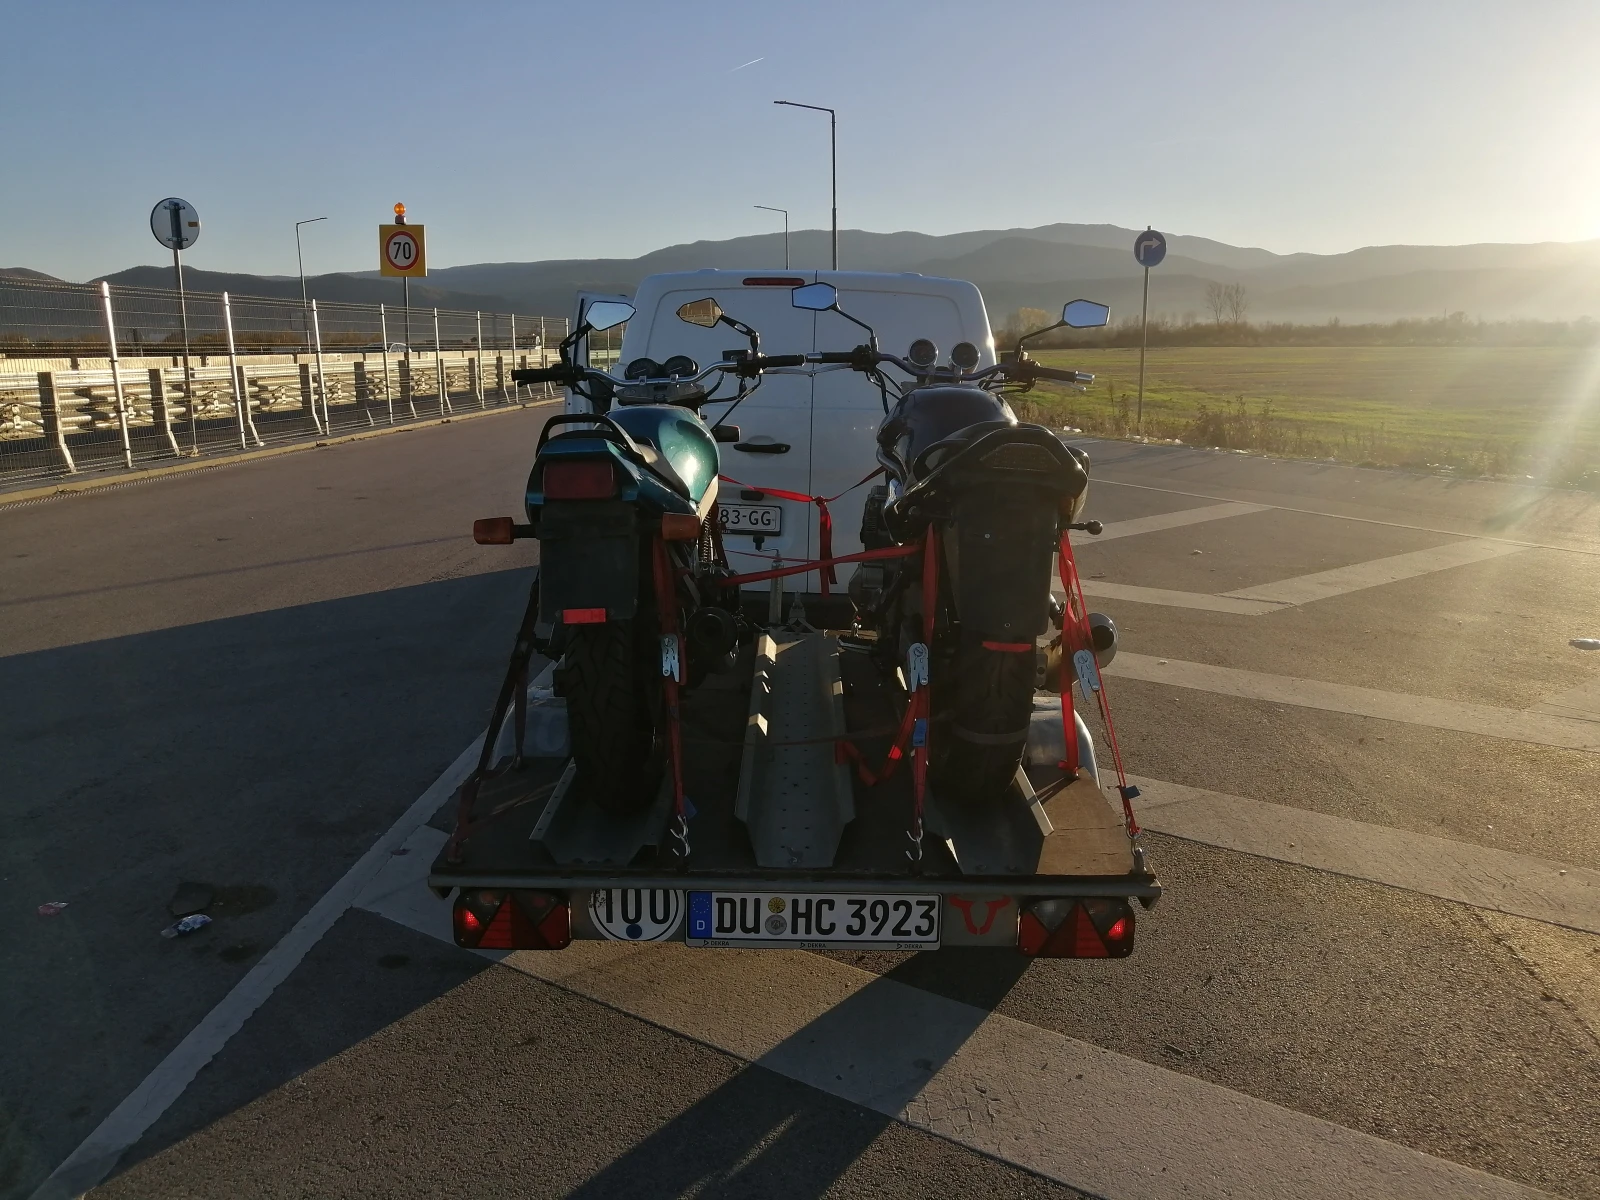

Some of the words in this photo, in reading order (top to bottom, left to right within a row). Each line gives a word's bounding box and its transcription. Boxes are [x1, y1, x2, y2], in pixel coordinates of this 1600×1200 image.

[393, 241, 412, 260] 70
[696, 920, 705, 930] D
[715, 897, 761, 934] DU
[790, 898, 836, 935] HC
[846, 899, 936, 936] 3923
